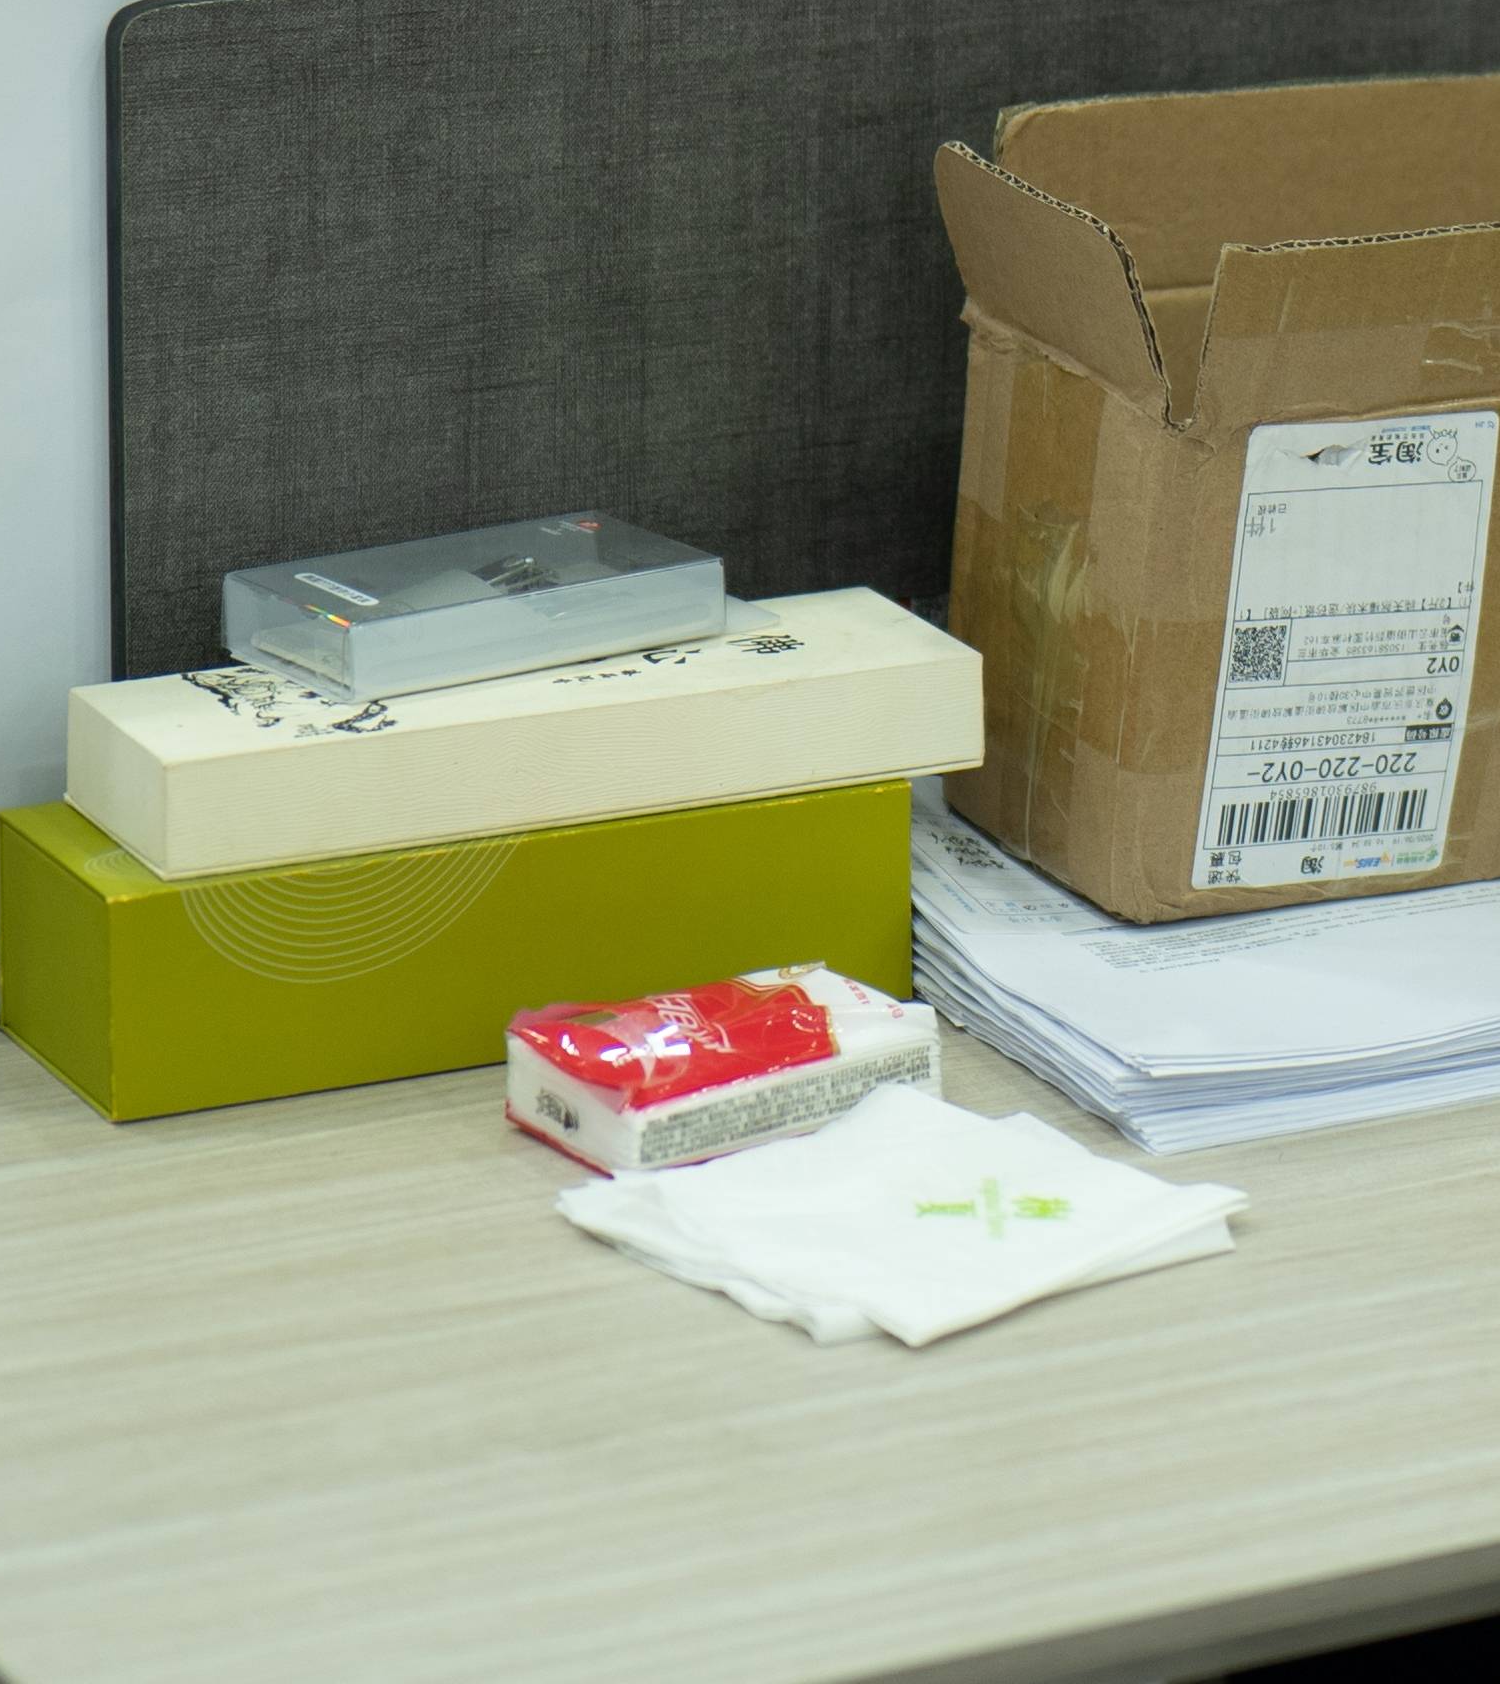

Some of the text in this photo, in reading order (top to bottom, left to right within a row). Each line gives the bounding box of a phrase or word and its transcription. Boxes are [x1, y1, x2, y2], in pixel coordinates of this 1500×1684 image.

[1367, 440, 1423, 464] 淘宝
[1268, 781, 1376, 801] 9879301865854
[1208, 849, 1242, 867] 包裹
[1300, 855, 1324, 874] 淘
